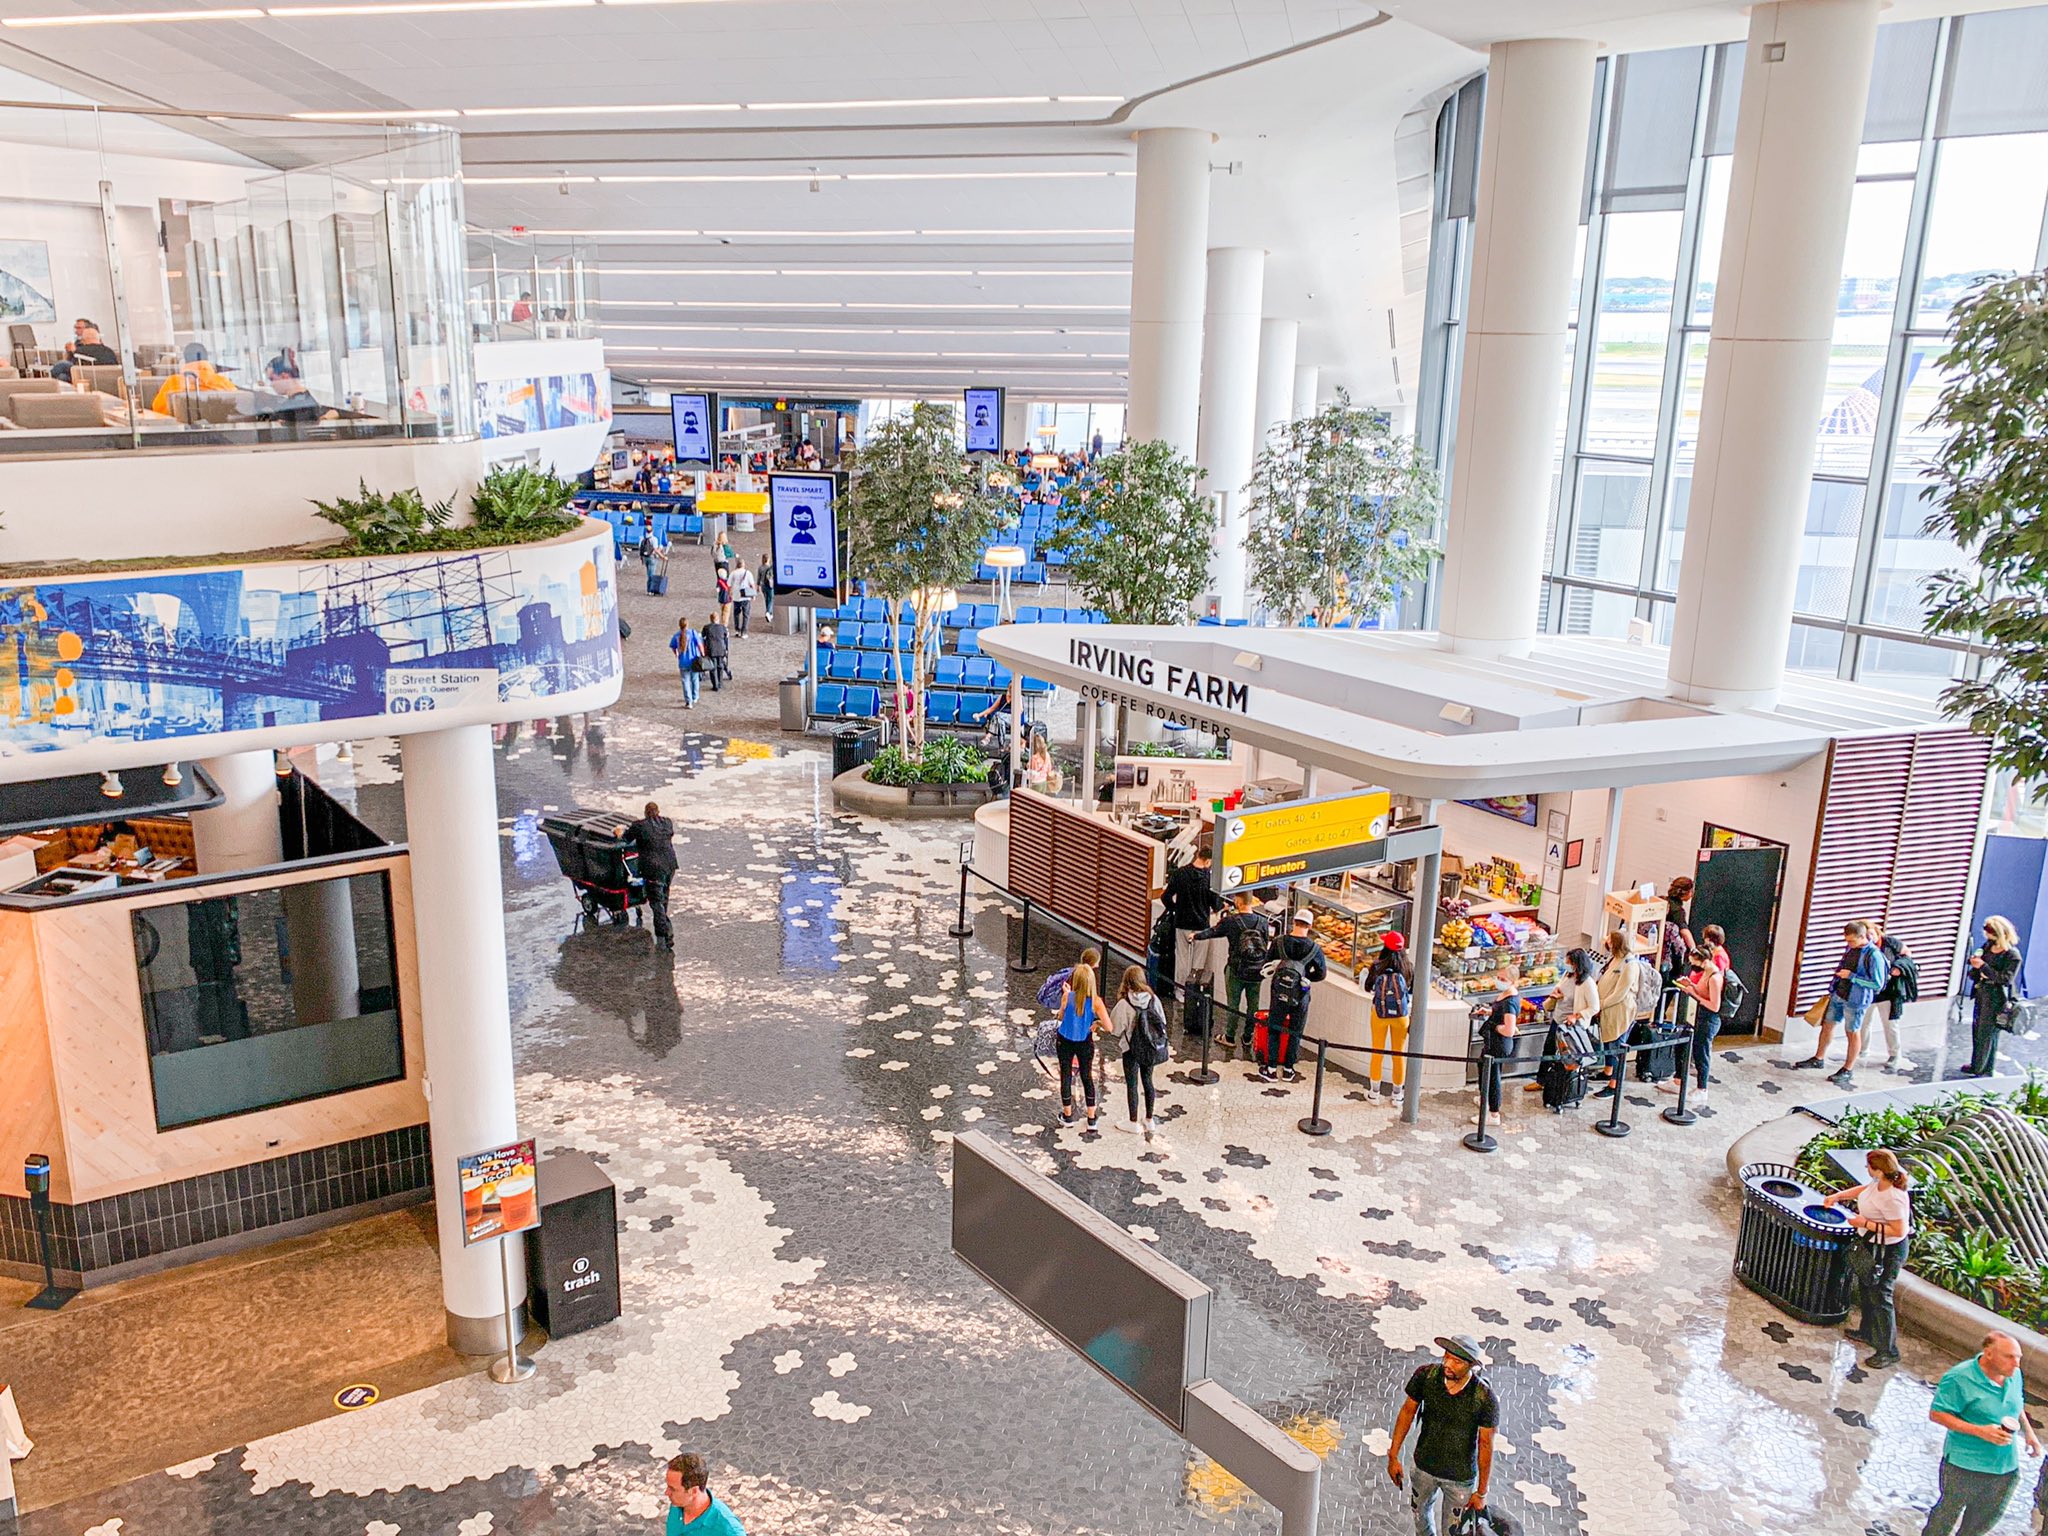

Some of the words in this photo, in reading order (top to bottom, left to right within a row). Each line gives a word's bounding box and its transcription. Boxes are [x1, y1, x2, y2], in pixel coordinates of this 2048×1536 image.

[402, 675, 436, 685] Street
[441, 674, 480, 684] Station
[1069, 638, 1154, 686] IRVING
[1167, 665, 1249, 714] FARM
[1081, 685, 1137, 711] COFFEE
[1146, 703, 1231, 740] ROASTERS
[1265, 818, 1291, 828] Gates
[1310, 811, 1321, 820] 41
[1286, 837, 1312, 848] Gates
[1315, 833, 1326, 842] 42
[1329, 832, 1337, 841] to
[1340, 829, 1351, 838] 47
[1549, 844, 1559, 858] A
[1260, 860, 1307, 877] Elevators
[477, 1154, 492, 1164] We
[494, 1148, 516, 1160] Have
[471, 1166, 490, 1176] Beer
[502, 1157, 523, 1168] Wine
[563, 1270, 600, 1291] trash
